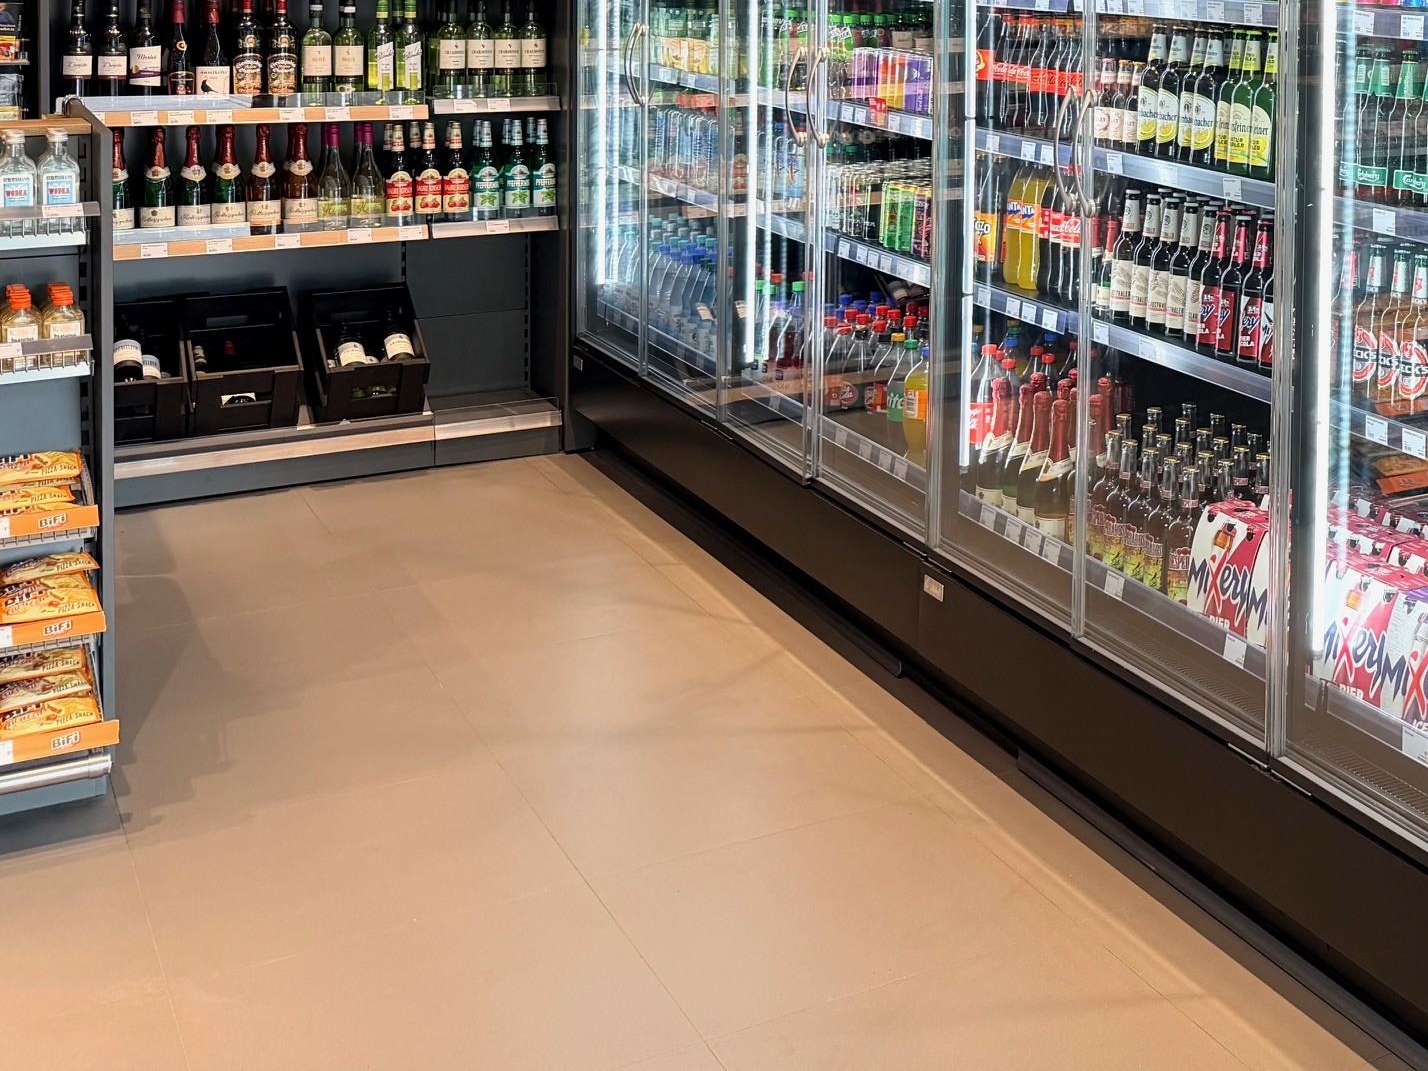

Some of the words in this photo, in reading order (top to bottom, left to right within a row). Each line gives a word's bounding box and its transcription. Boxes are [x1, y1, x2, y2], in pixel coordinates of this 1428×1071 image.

[48, 187, 70, 195] WODKA
[38, 513, 67, 529] BiFi
[44, 620, 71, 635] BiFi
[51, 732, 80, 750] BiFi
